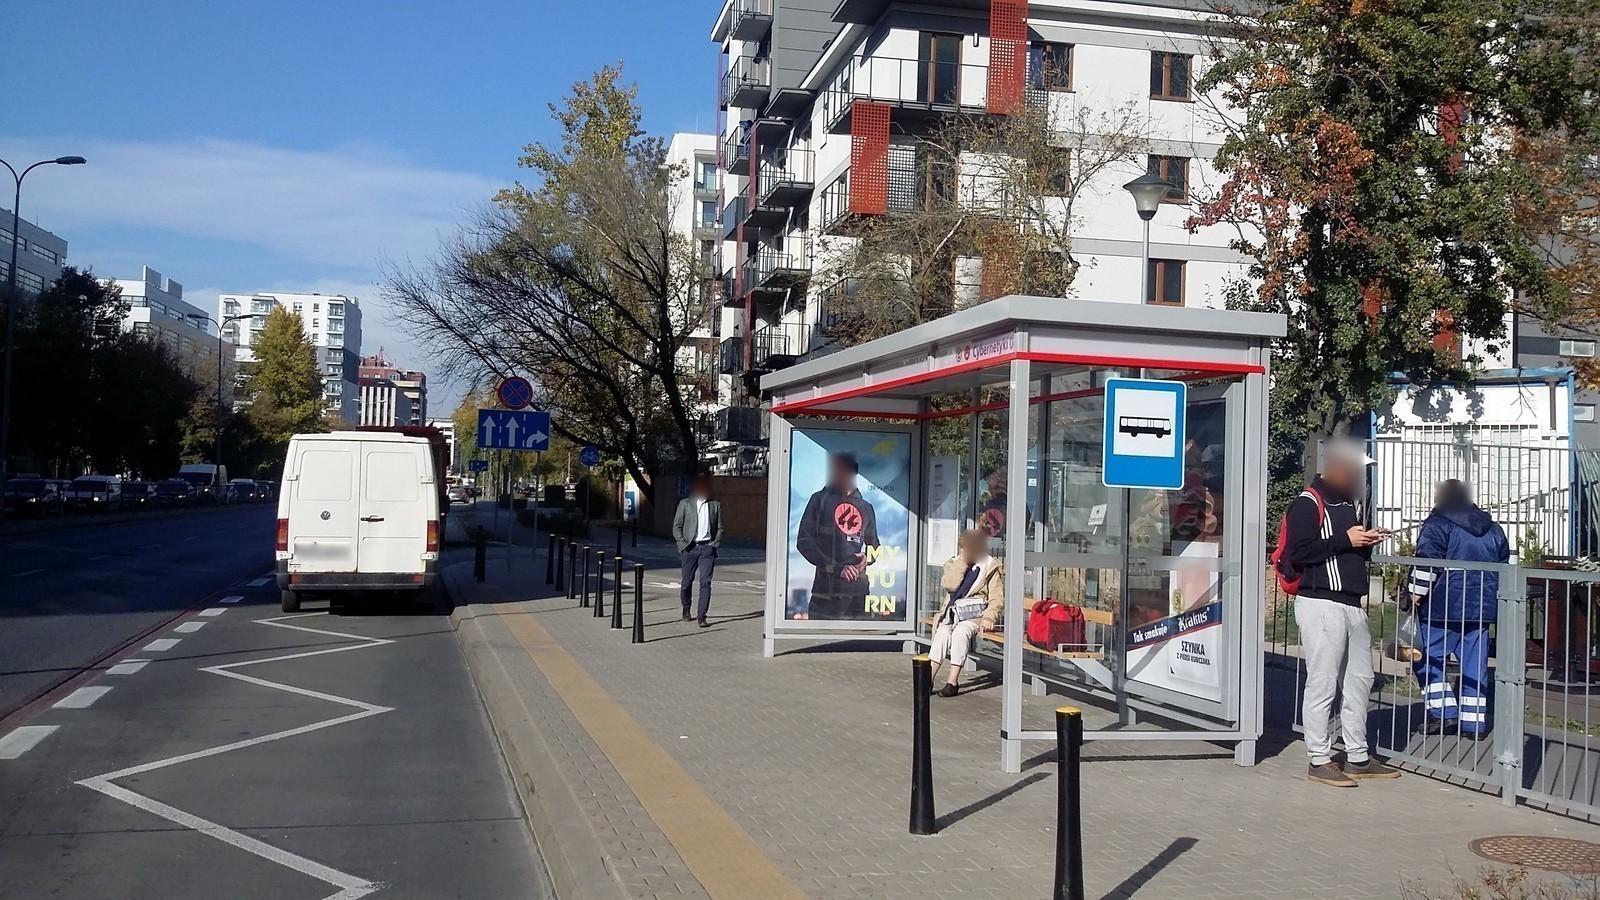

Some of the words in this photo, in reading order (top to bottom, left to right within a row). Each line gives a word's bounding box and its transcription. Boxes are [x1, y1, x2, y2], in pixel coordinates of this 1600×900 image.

[866, 545, 900, 563] MY
[867, 570, 896, 588] TU
[865, 594, 896, 613] RN
[1133, 630, 1144, 643] Tak
[1144, 624, 1168, 640] smakuje
[1181, 641, 1205, 655] SZYNKA
